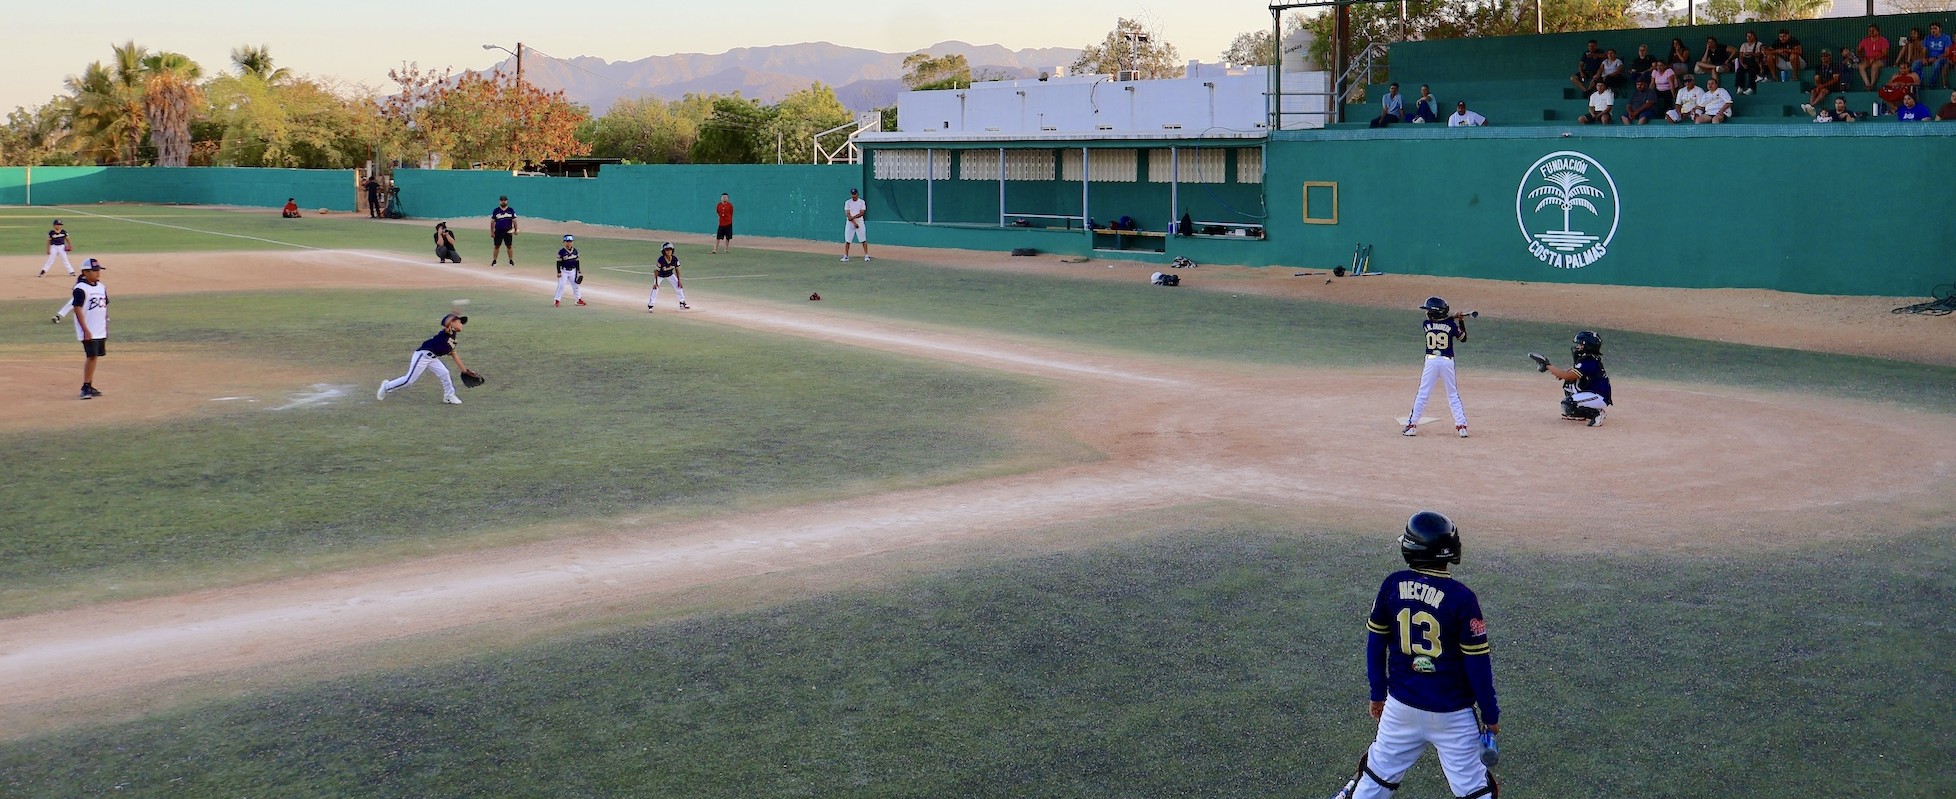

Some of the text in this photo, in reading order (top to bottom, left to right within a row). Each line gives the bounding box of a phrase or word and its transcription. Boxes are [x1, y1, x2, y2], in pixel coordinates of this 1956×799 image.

[1540, 158, 1588, 177] FUNDACIÓN
[1528, 240, 1607, 269] COSTA PALMAS
[1426, 331, 1449, 350] 09
[1398, 580, 1445, 609] HECTOR
[1396, 607, 1443, 659] 13
